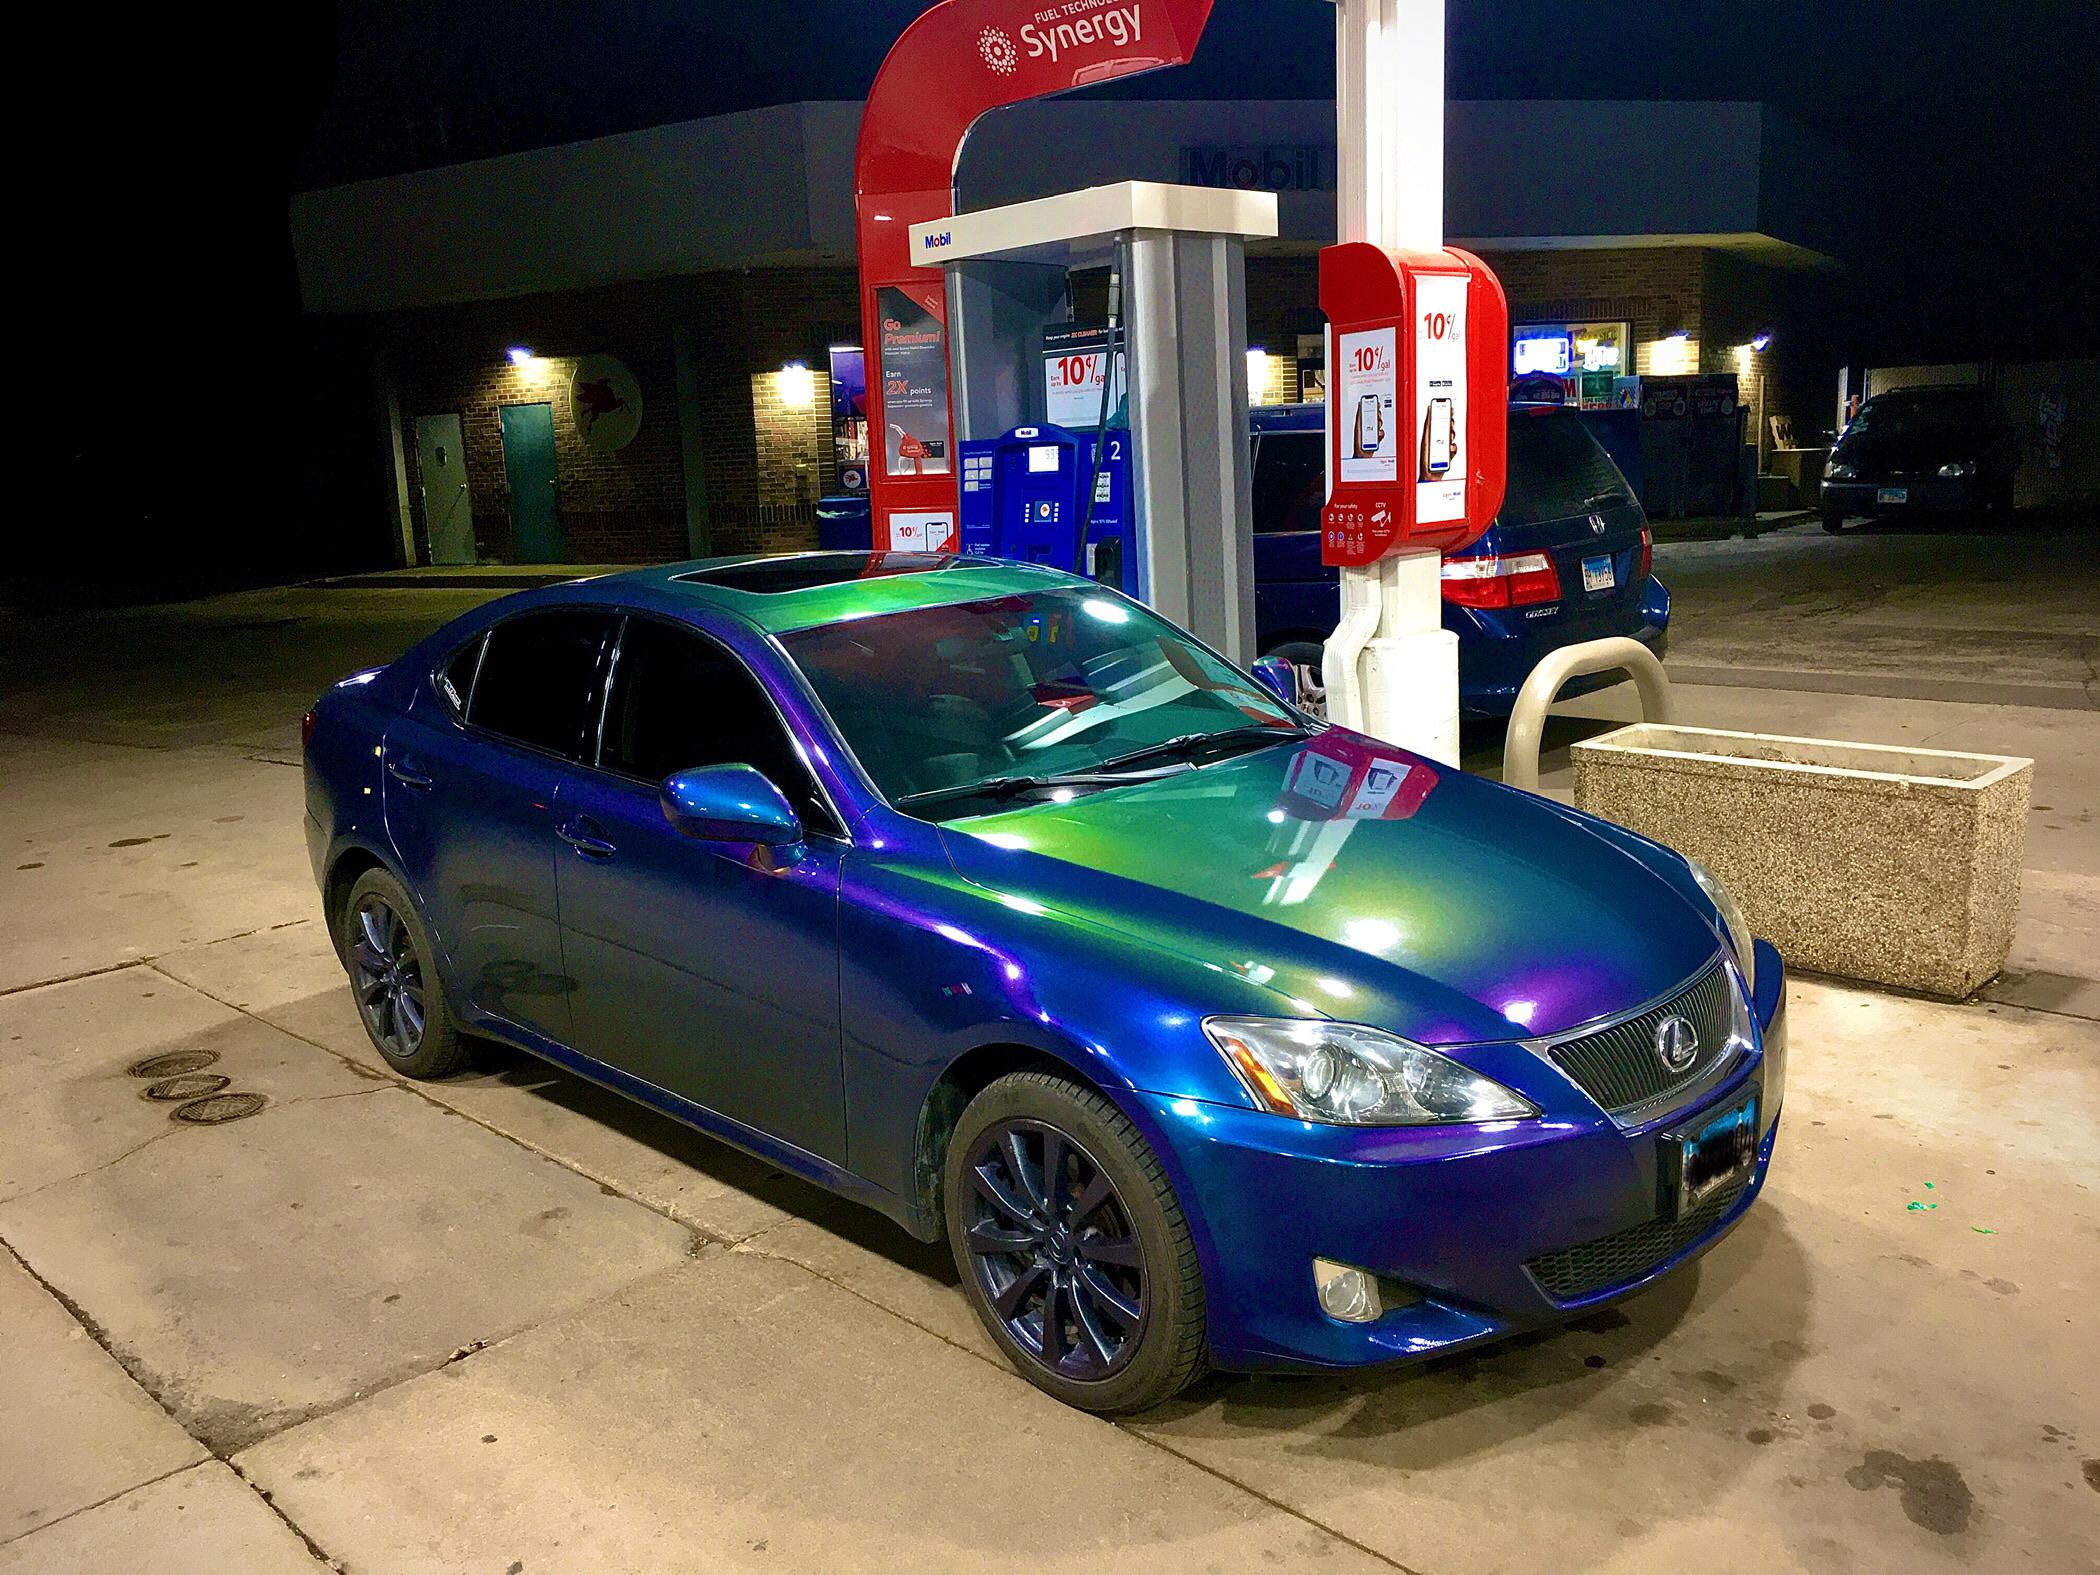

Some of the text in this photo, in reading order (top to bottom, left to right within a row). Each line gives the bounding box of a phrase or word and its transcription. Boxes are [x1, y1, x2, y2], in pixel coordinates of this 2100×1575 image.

[1034, 8, 1061, 23] FUEL
[1020, 4, 1141, 62] Synergy
[1190, 150, 1318, 190] Mobil
[924, 231, 952, 249] Mobil
[884, 318, 901, 331] Go
[885, 370, 902, 378] Earn
[886, 380, 932, 397] 2X points
[1110, 440, 1121, 460] 2
[1525, 606, 1560, 619] ODYSSEY
